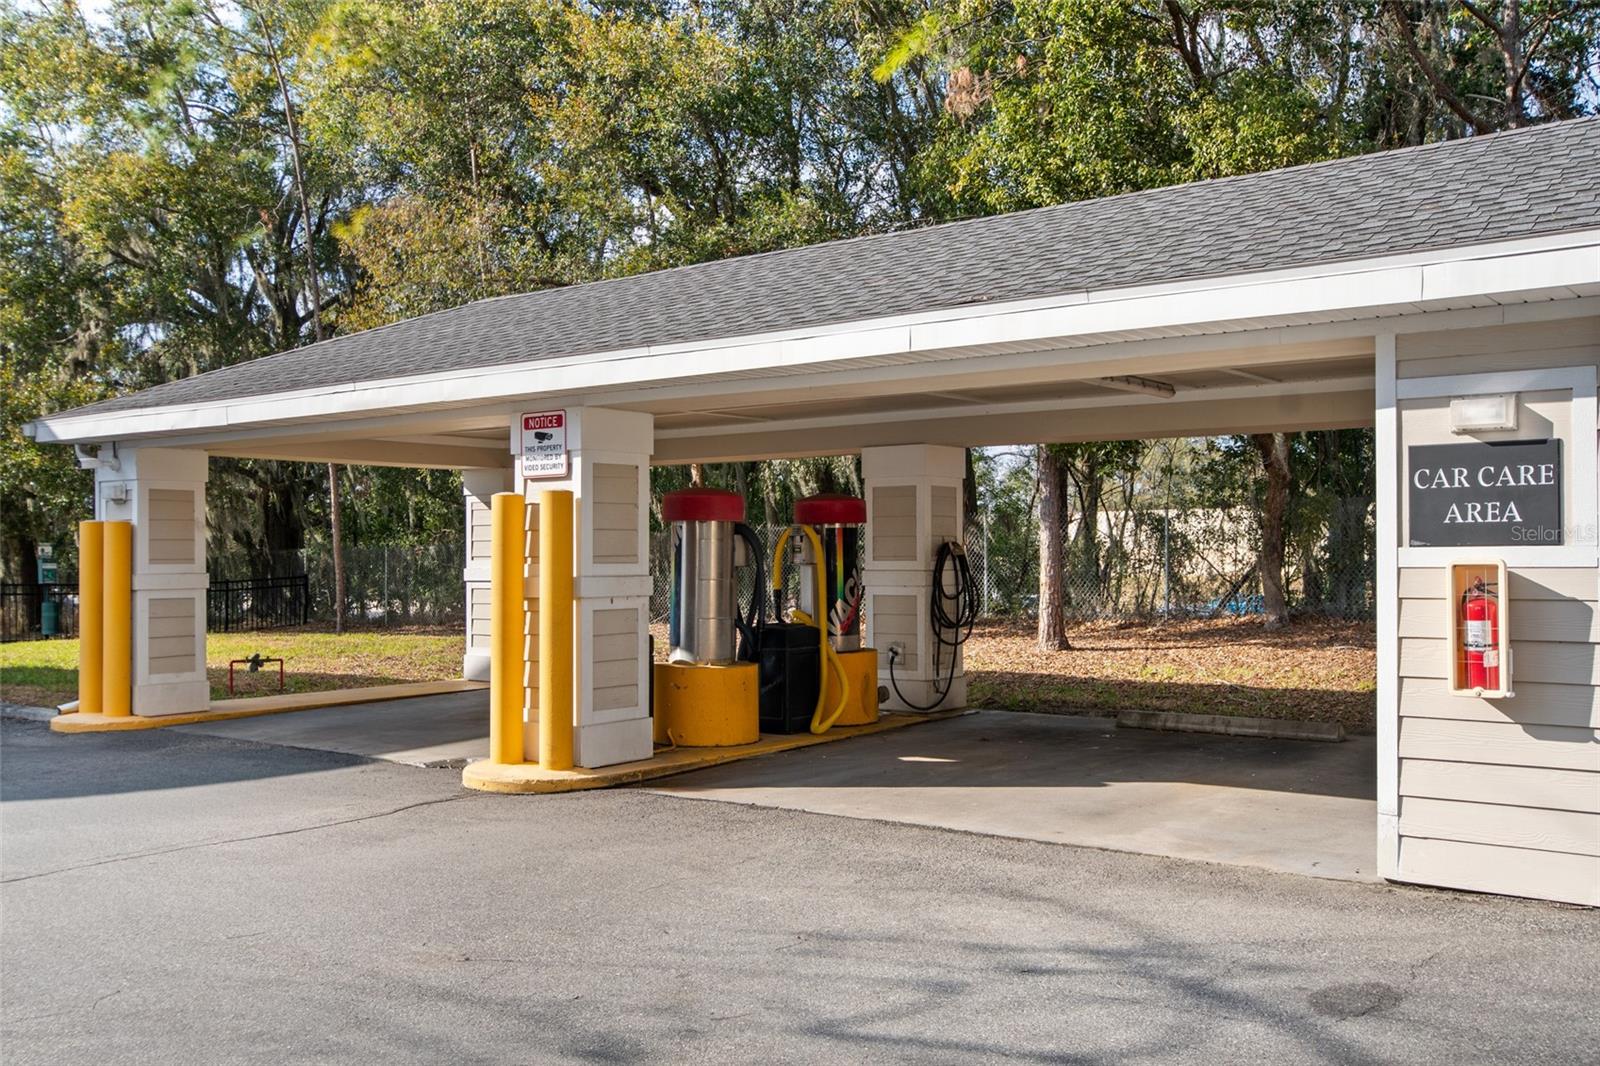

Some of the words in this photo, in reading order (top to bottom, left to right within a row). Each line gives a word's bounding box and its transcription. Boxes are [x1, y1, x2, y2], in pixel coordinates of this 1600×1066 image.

[528, 416, 558, 429] NOTICE
[537, 444, 562, 452] PROPERTY
[540, 463, 563, 471] SECURITY
[1413, 467, 1470, 489] CAR
[1477, 464, 1555, 487] CARE
[1443, 501, 1523, 524] AREA
